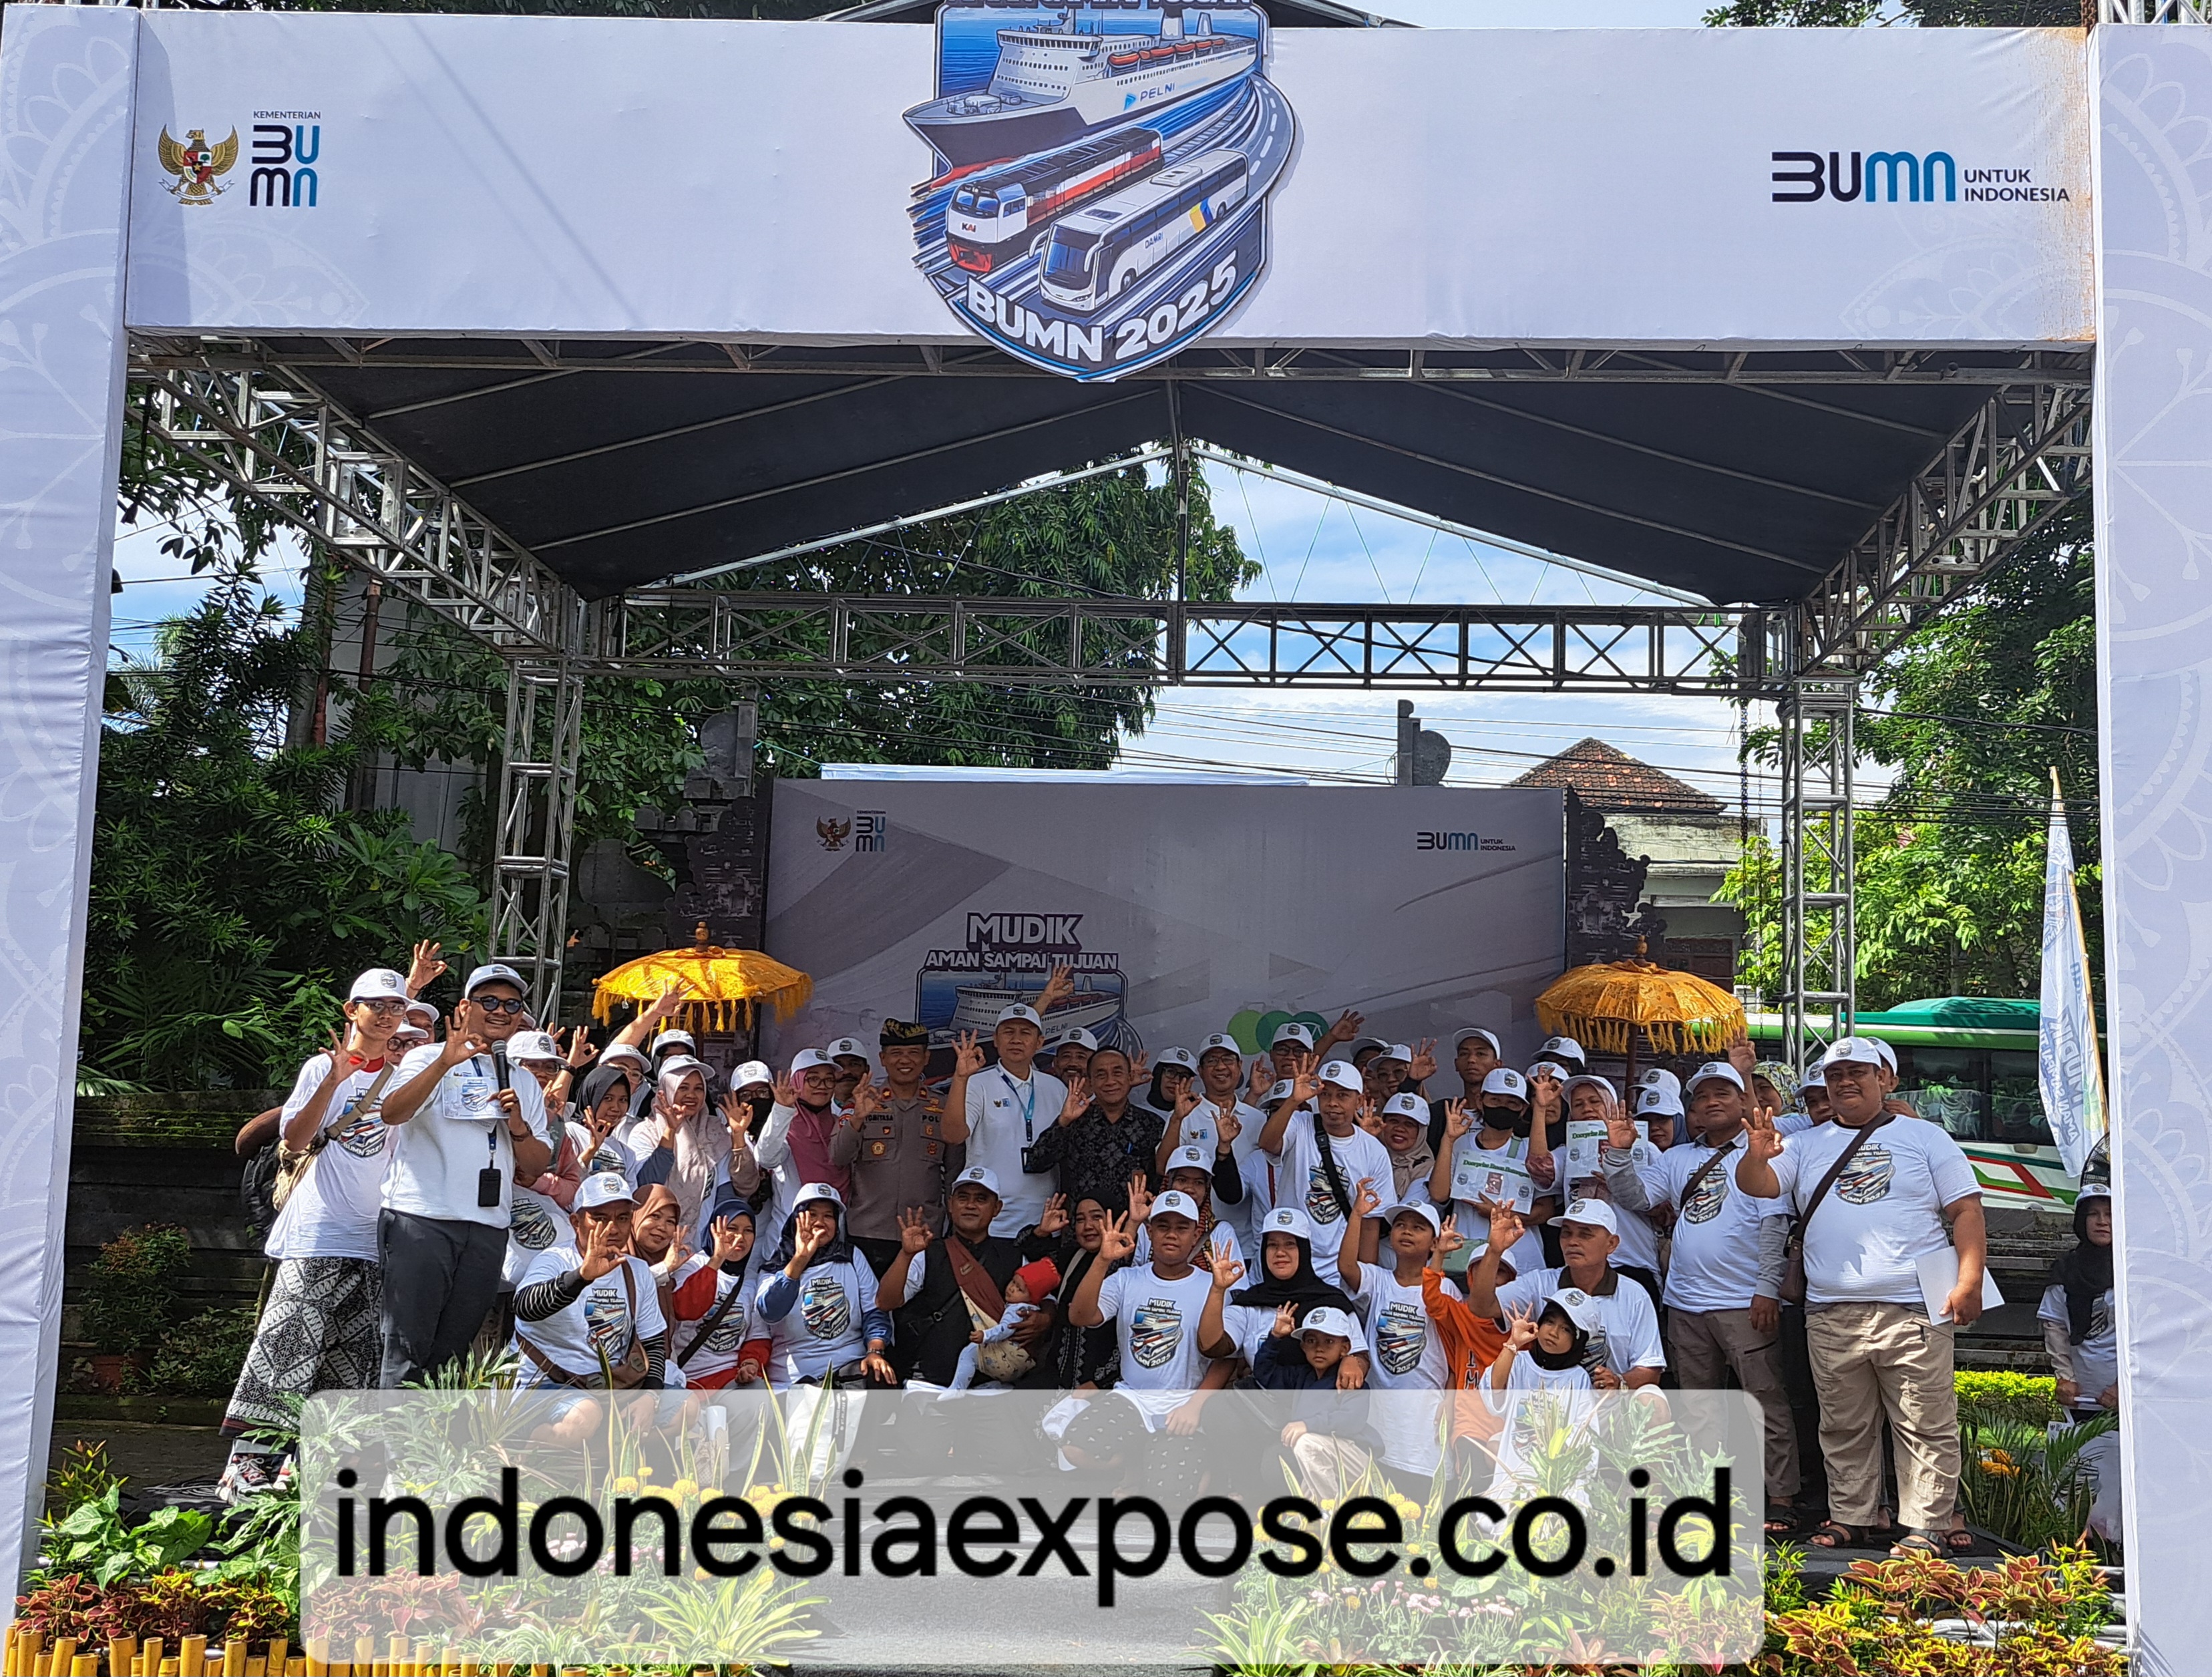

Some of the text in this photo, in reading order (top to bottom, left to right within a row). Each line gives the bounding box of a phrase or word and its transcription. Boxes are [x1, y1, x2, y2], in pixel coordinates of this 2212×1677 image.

[1140, 82, 1175, 102] PELNI
[253, 111, 321, 119] KEMENTERIAN
[1964, 170, 2031, 183] UNTUK
[1965, 188, 2070, 202] INDONESIA
[962, 222, 976, 232] KAI
[1145, 232, 1163, 249] DAMRI
[968, 250, 1236, 361] BUMN 2025
[969, 916, 1077, 944] MUDIK
[926, 951, 1117, 969] AMAN SAMPAI TUJUAN
[1858, 1143, 1880, 1151] UDIK
[593, 1289, 616, 1297] MUDIK
[1149, 1298, 1174, 1308] MUDIK
[1391, 1302, 1417, 1314] MUDIK
